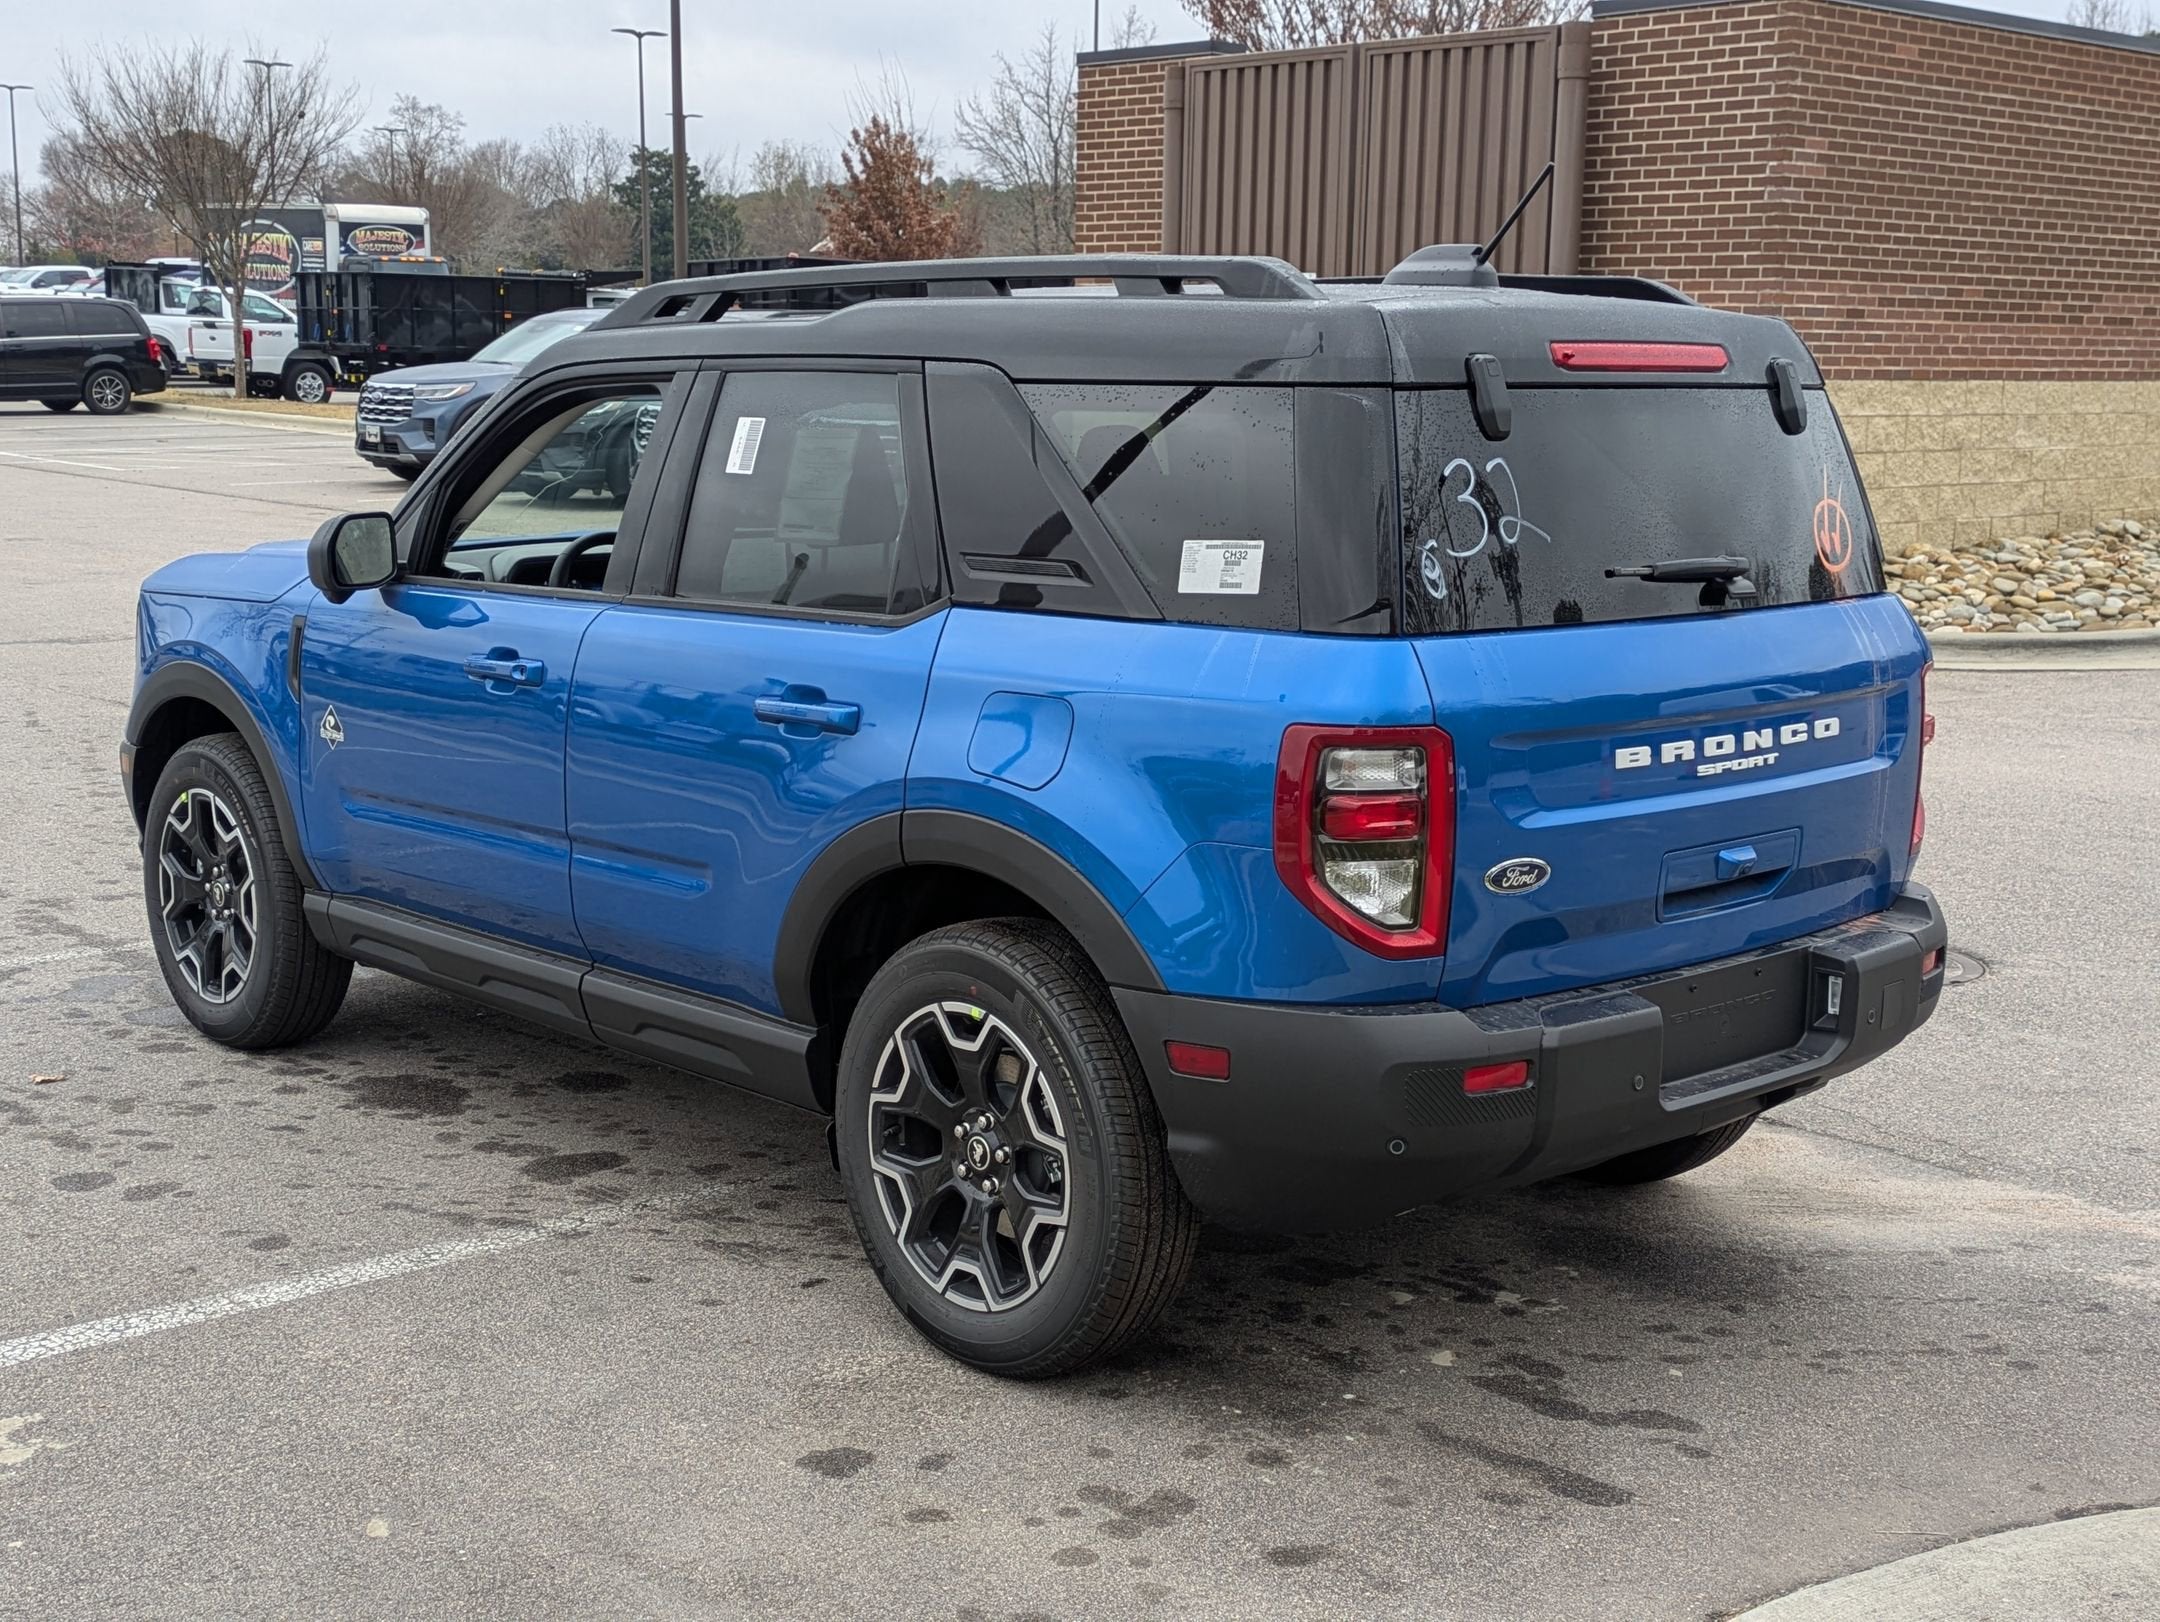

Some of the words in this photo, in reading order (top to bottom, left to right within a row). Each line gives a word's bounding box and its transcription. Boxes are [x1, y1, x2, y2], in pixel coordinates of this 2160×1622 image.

[235, 232, 293, 263] AJESTIC
[355, 230, 409, 245] MAJESTIC
[358, 243, 407, 253] SOLUTIONS
[244, 263, 291, 280] LUTIONS
[1222, 550, 1248, 560] CH32
[1615, 717, 1840, 770] BRONCO
[1697, 752, 1779, 777] SPORT
[1501, 866, 1539, 887] Ford
[1670, 988, 1777, 1024] BRONCO
[1041, 1033, 1094, 1153] MICHELIN
